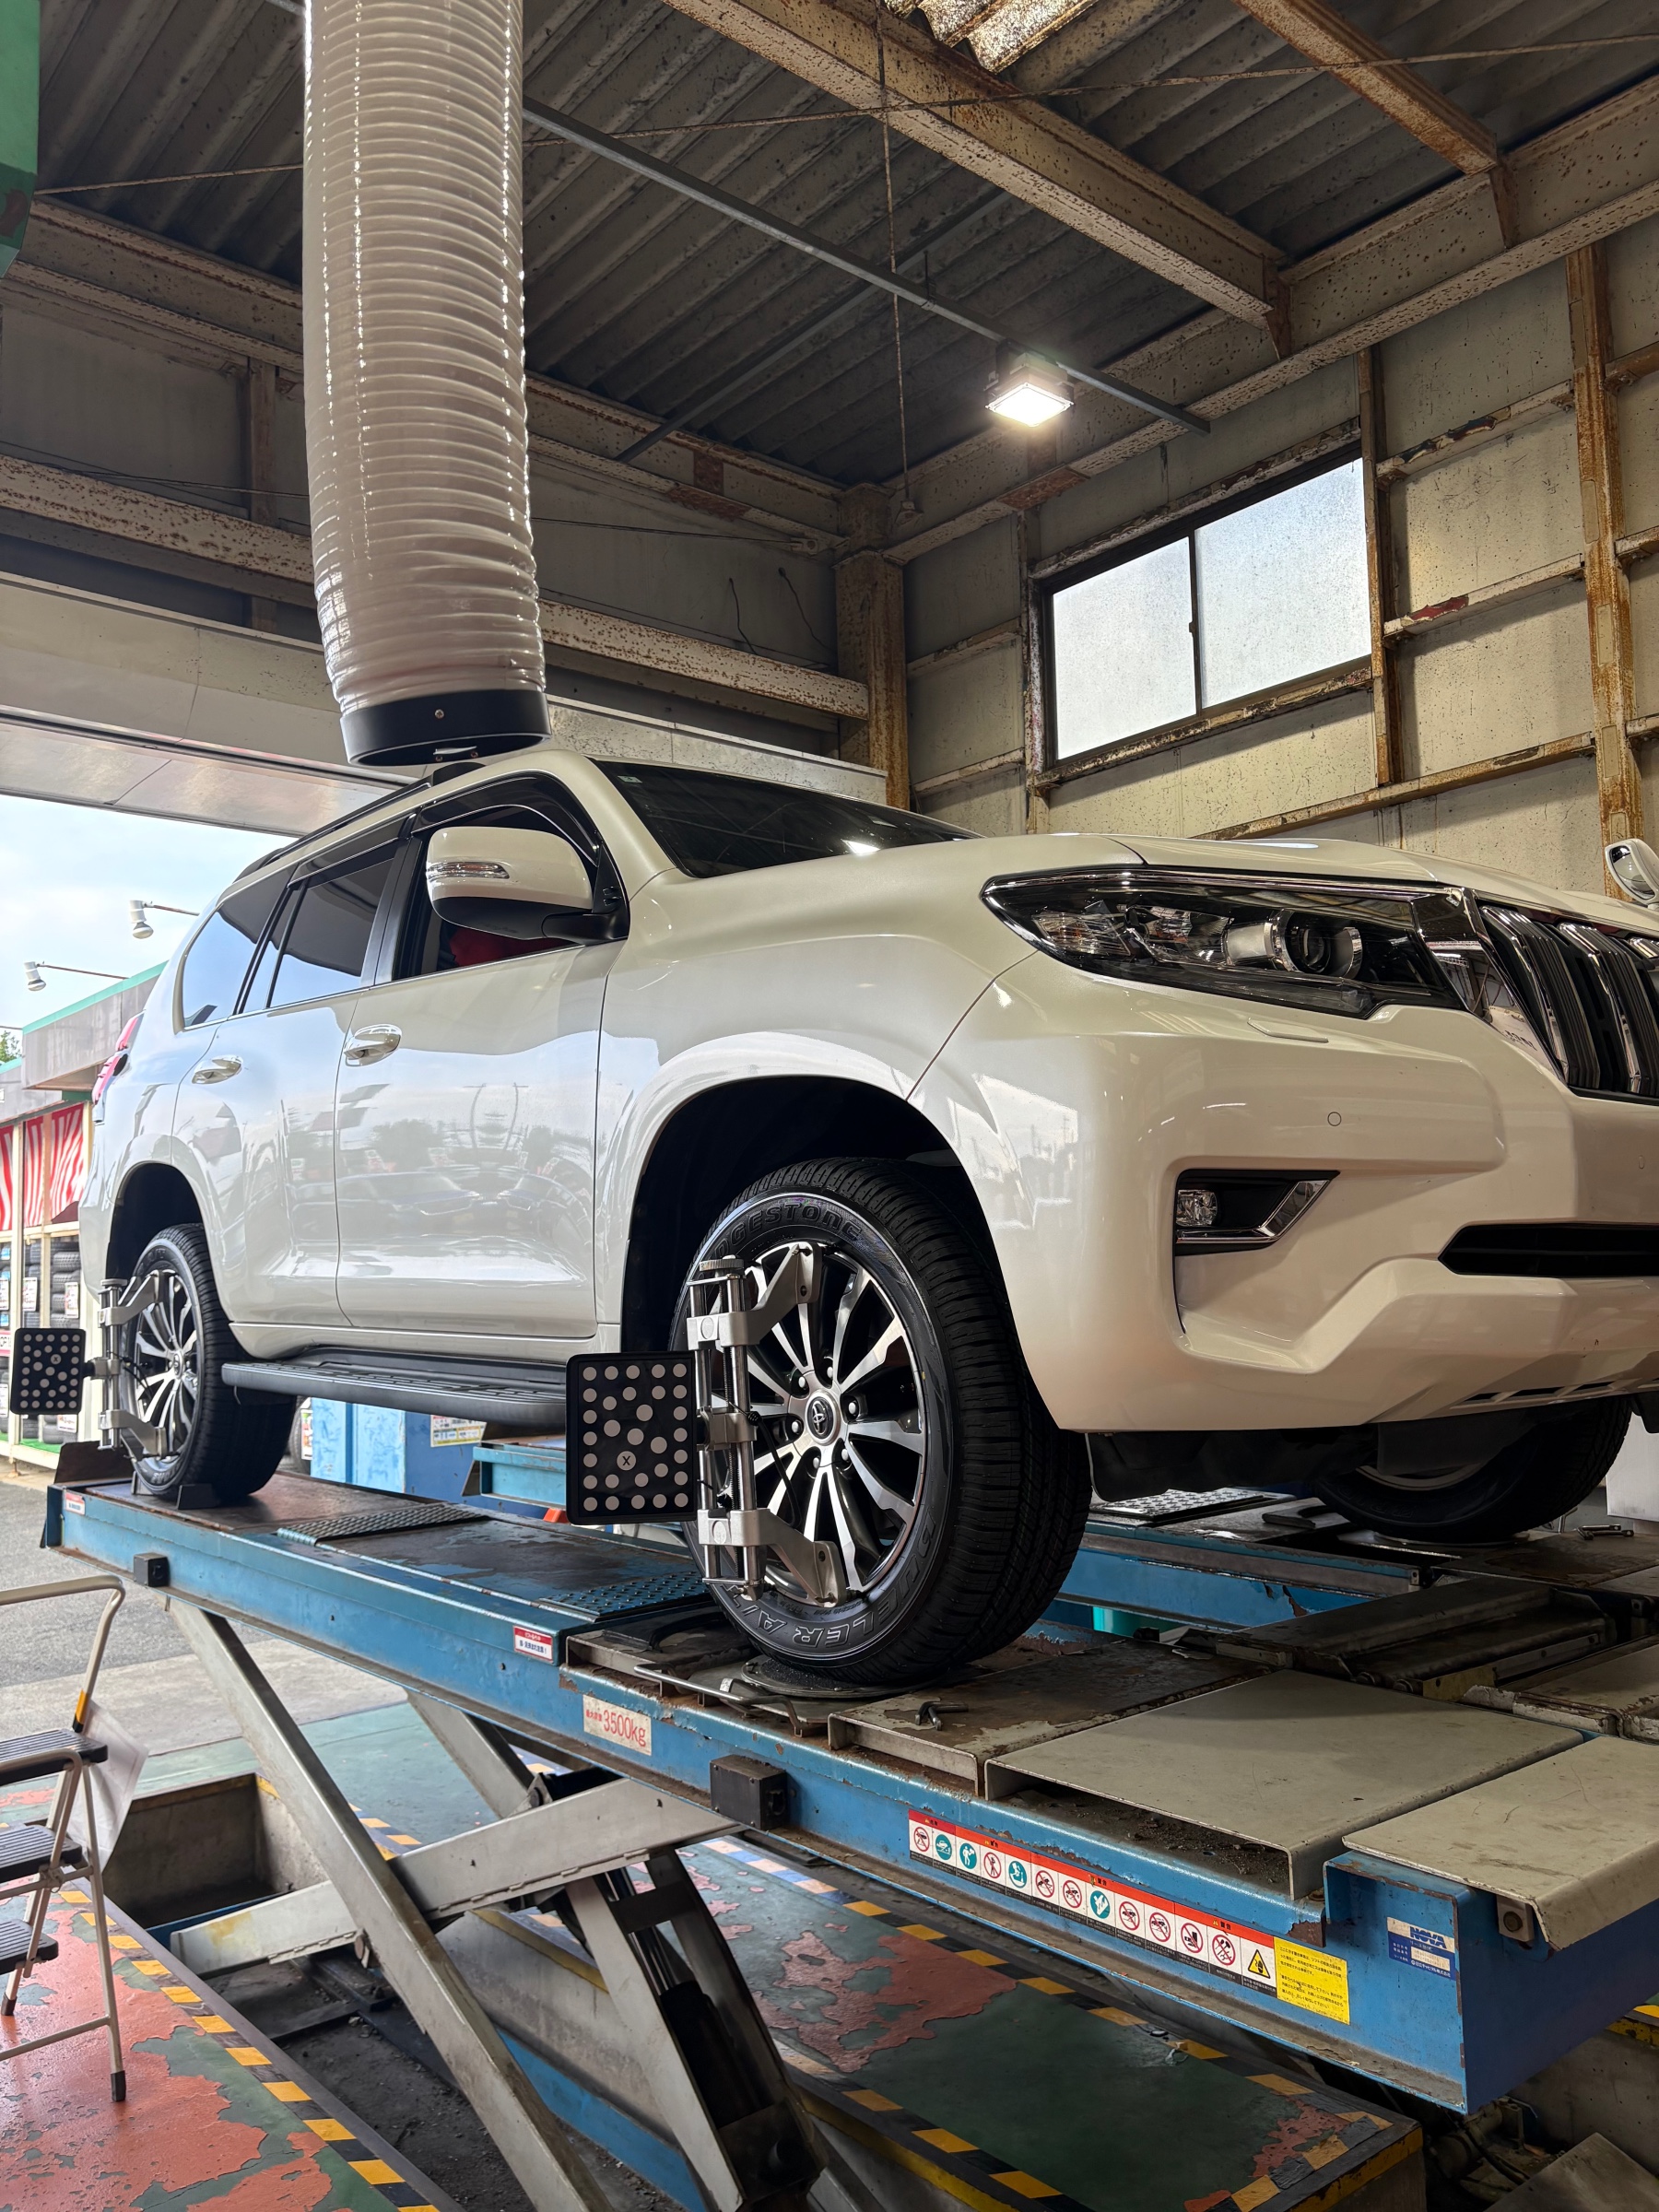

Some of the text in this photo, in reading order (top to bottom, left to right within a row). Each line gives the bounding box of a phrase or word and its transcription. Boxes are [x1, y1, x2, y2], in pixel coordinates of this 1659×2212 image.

[792, 1508, 936, 1649] DUELER
[604, 1710, 646, 1747] 3500kg
[1410, 1926, 1447, 1949] NOVA
